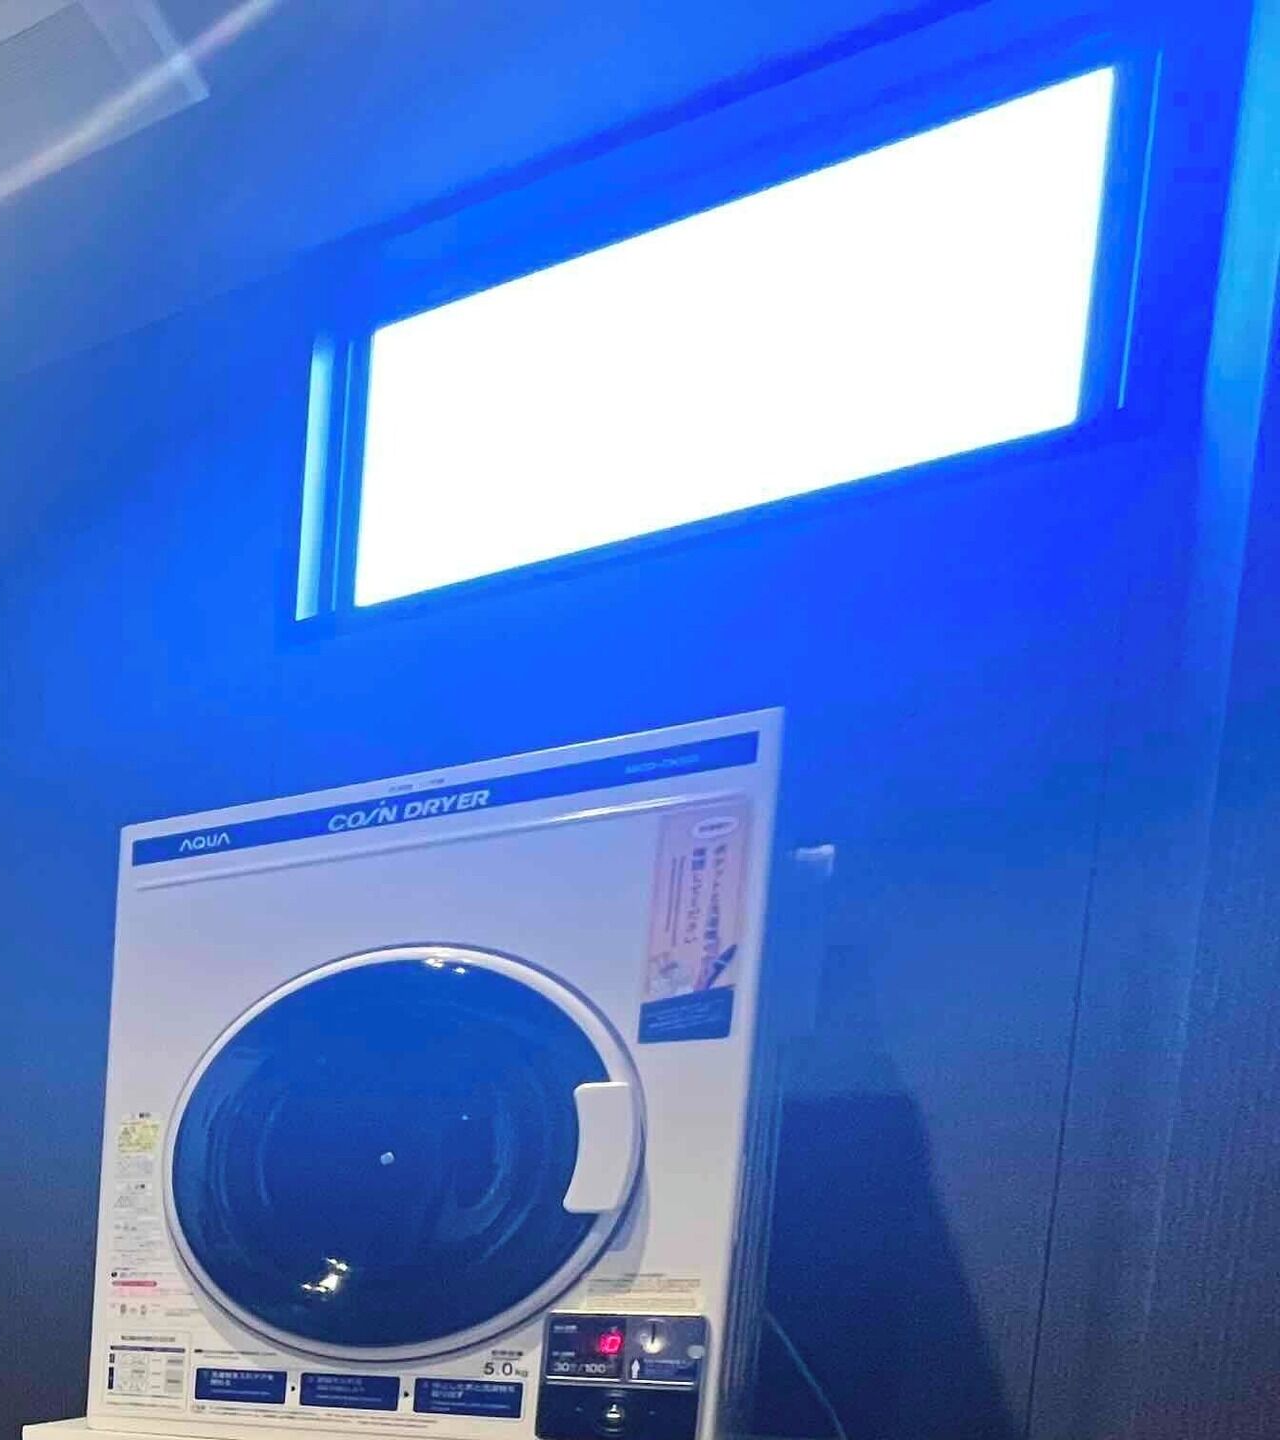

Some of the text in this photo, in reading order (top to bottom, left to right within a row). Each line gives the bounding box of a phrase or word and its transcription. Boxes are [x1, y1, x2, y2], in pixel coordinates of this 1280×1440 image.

[402, 789, 490, 820] DRYER
[179, 831, 231, 852] AQUA
[483, 1361, 513, 1376] 5.0
